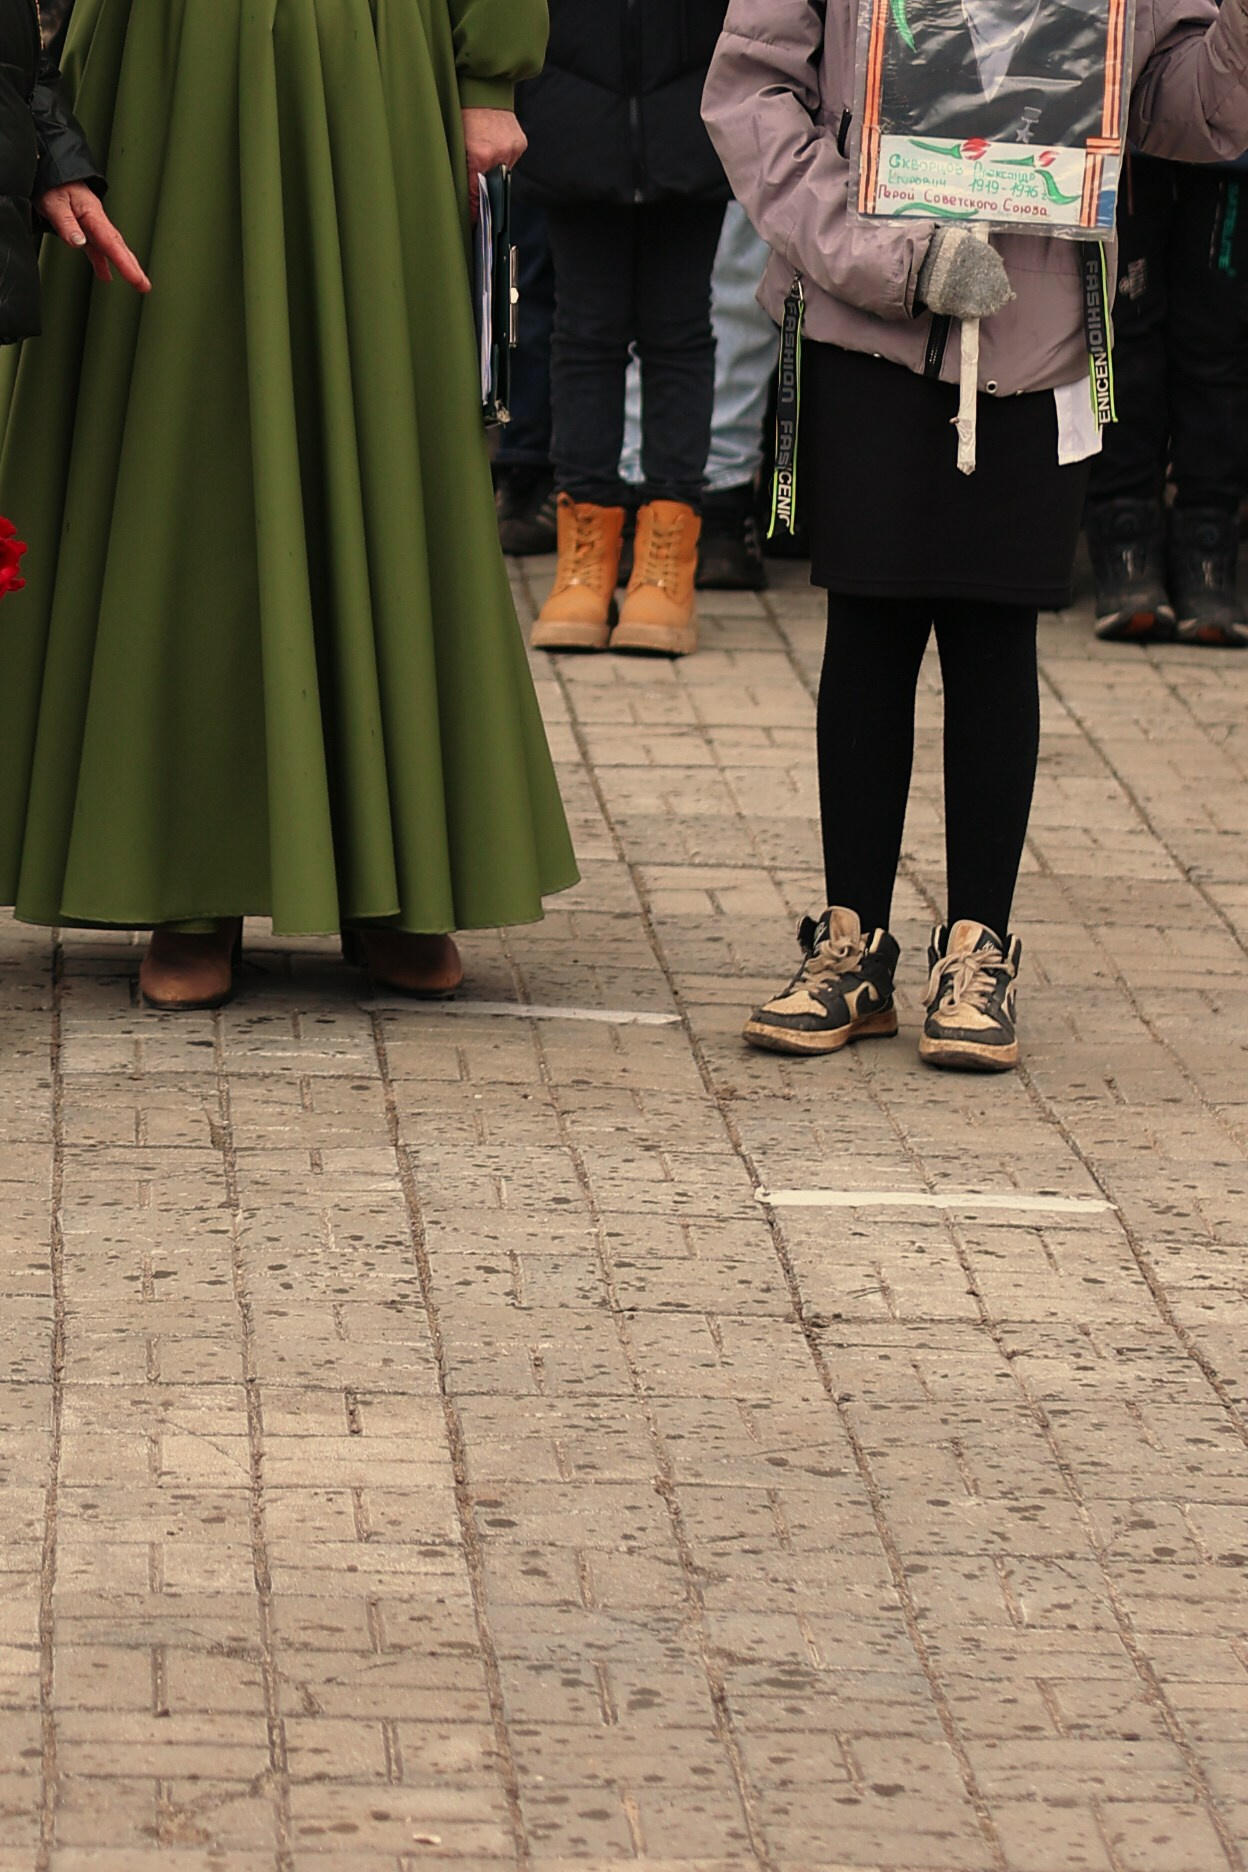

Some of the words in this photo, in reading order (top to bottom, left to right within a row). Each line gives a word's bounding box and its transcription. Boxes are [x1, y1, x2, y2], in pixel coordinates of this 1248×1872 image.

[878, 184, 916, 201] Герой
[923, 189, 999, 211] Советского
[1003, 197, 1049, 217] Союза
[780, 301, 797, 403] FASHION
[776, 419, 794, 470] FAS
